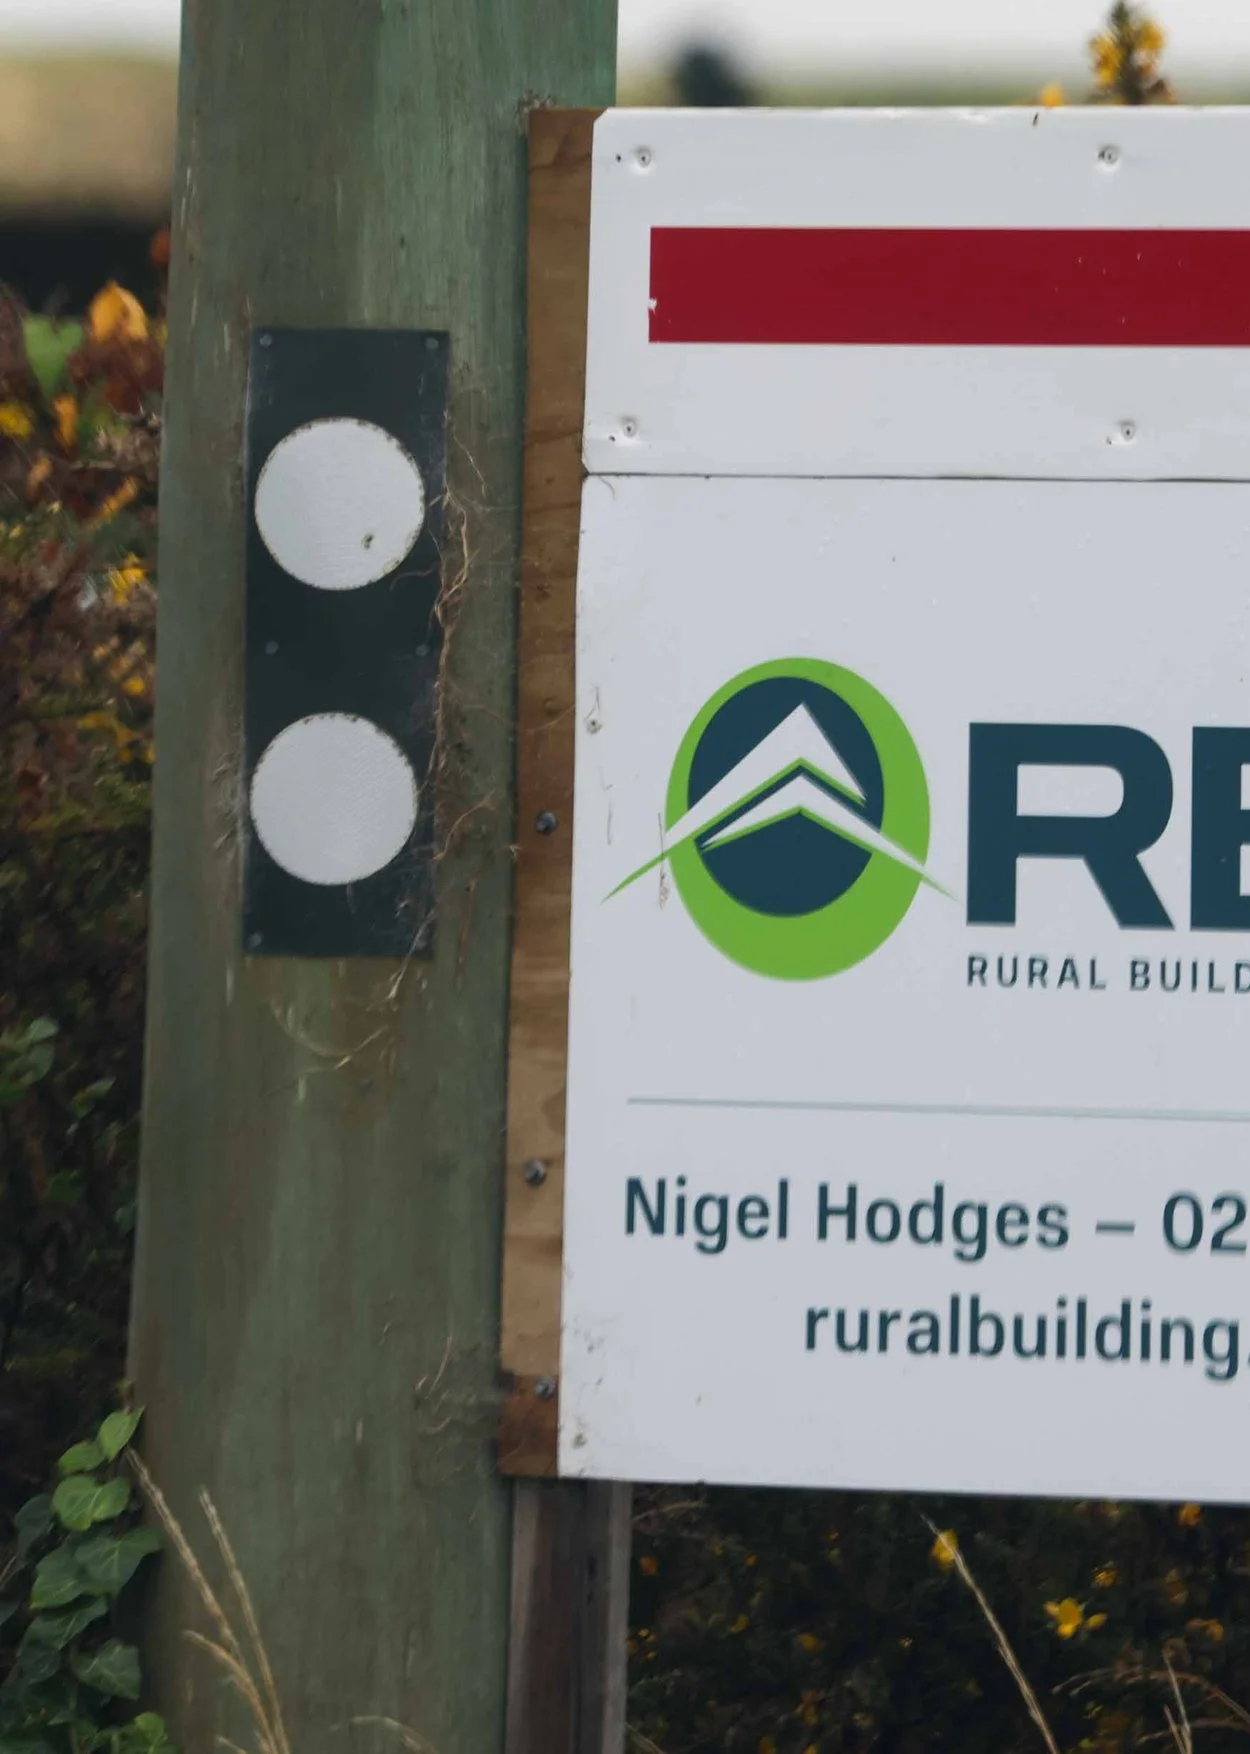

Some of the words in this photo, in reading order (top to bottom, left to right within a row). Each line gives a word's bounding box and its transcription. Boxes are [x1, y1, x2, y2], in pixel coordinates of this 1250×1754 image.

[967, 955, 1106, 989] RURAL
[625, 1175, 789, 1256] Nigel
[817, 1182, 1069, 1263] Hodges
